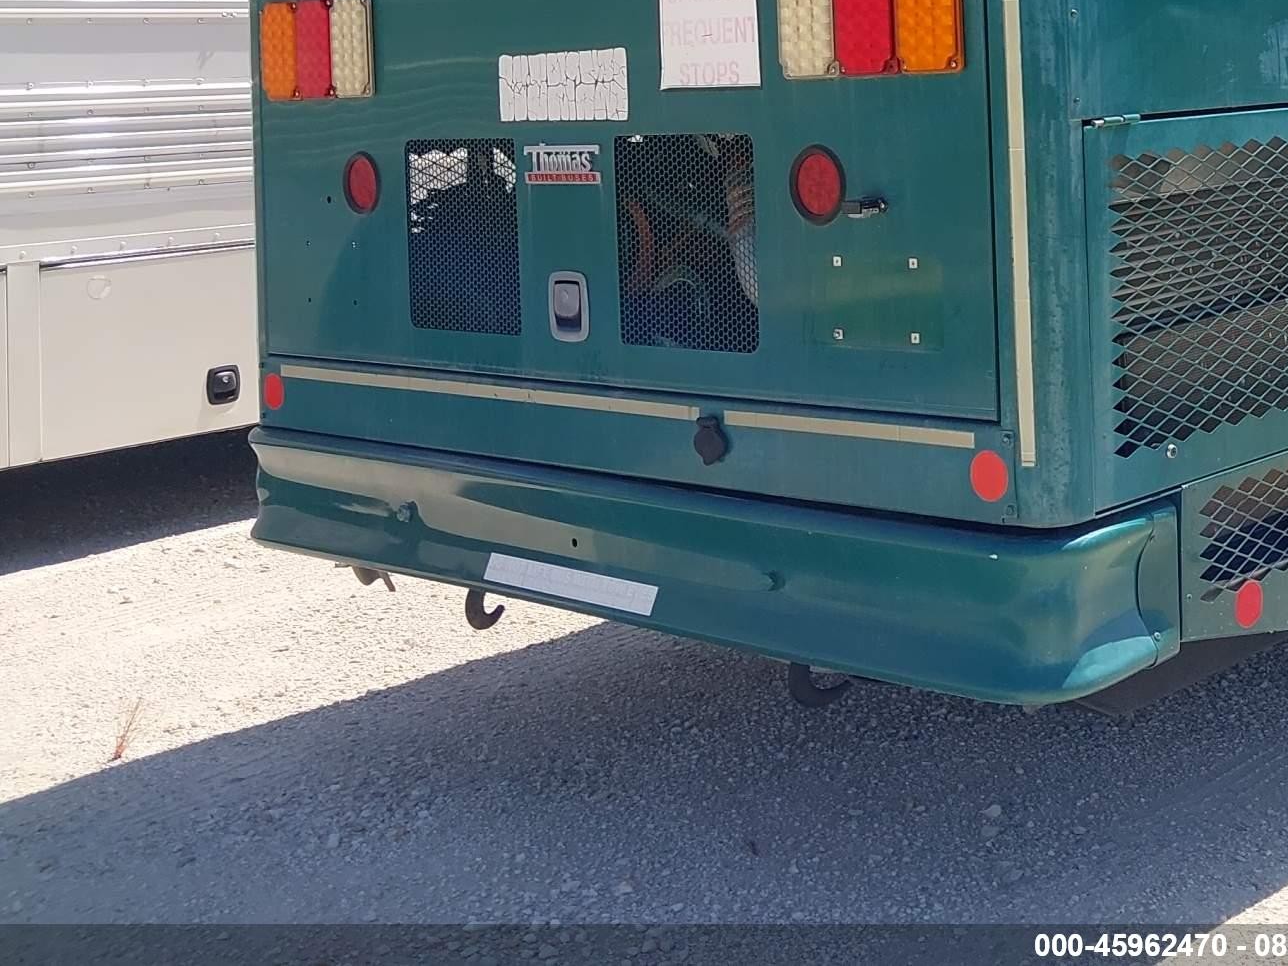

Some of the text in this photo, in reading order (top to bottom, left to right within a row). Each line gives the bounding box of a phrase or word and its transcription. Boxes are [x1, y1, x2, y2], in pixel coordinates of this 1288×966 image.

[679, 61, 740, 84] STOPS
[524, 143, 600, 173] Thomas
[531, 174, 594, 182] BUILT BUSES
